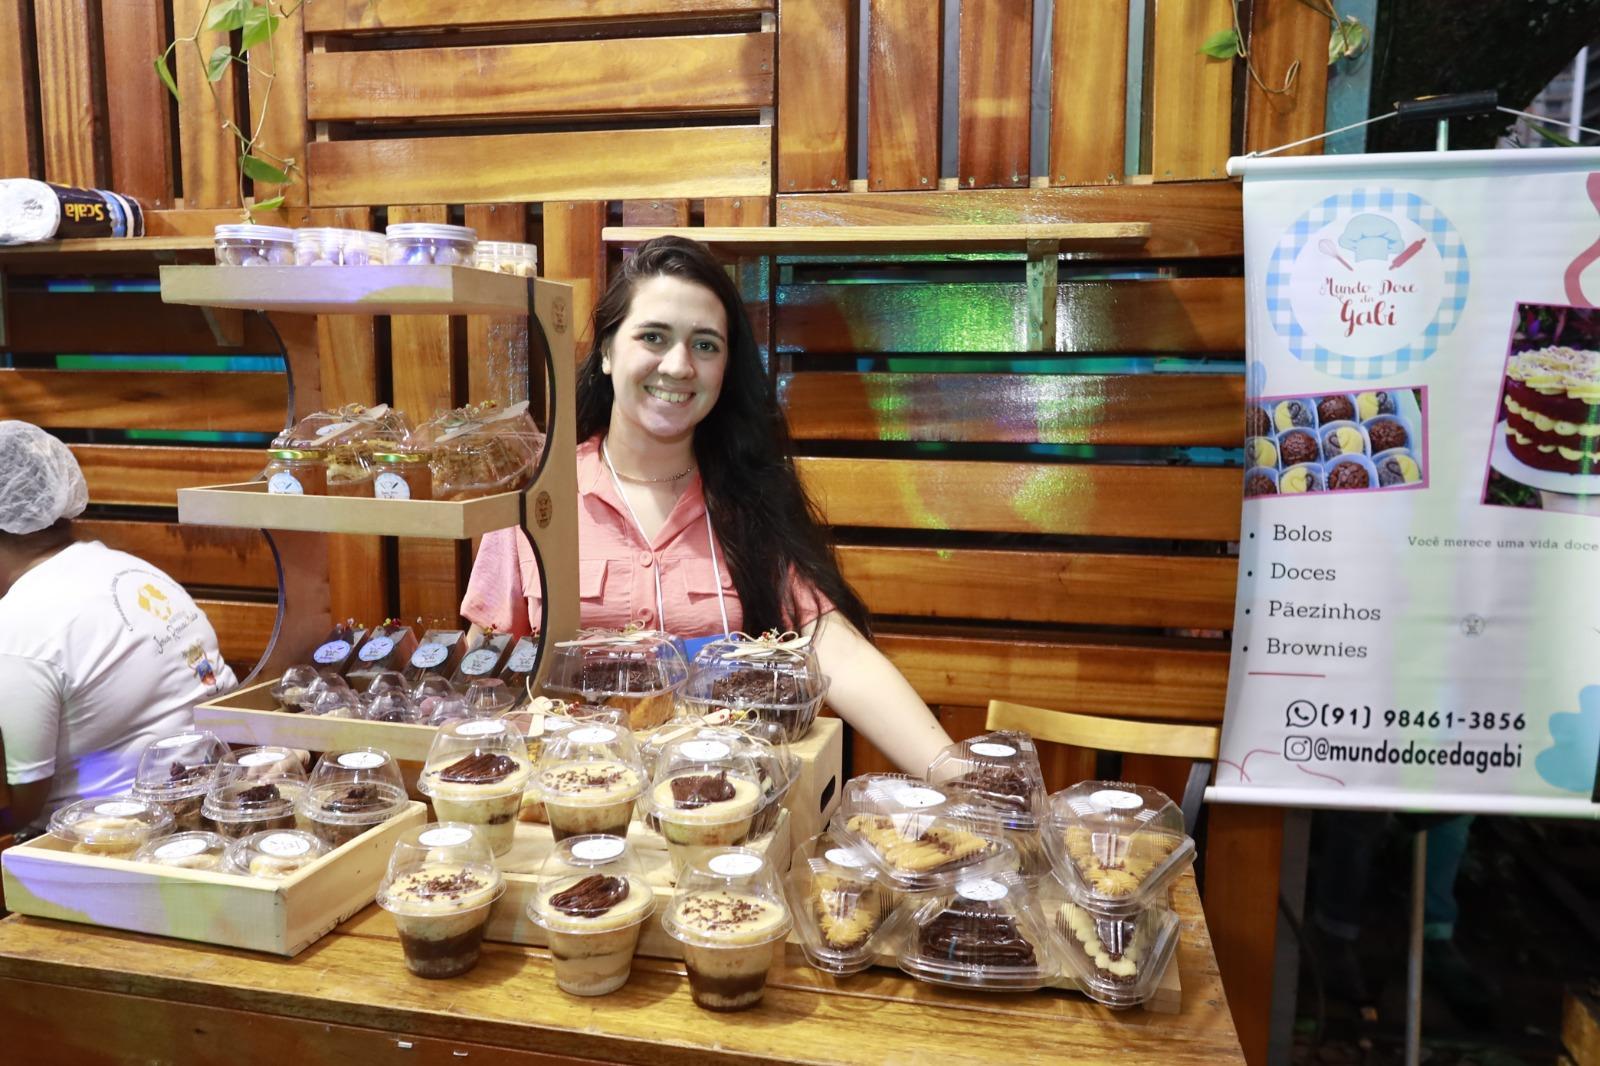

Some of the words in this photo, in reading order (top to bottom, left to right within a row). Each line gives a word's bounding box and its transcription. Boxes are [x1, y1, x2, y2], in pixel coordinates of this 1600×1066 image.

[64, 203, 105, 222] Scala
[1319, 277, 1371, 296] Mundo
[1379, 279, 1418, 295] Doce
[1340, 298, 1397, 338] Gabi
[1272, 523, 1333, 543] Bolos
[1407, 535, 1440, 547] Você
[1444, 538, 1492, 549] merece
[1496, 539, 1525, 549] uma
[1529, 538, 1559, 550] vida
[1270, 562, 1337, 582] Doces
[1268, 599, 1382, 621] Pãezinhos
[1266, 637, 1369, 659] Brownies
[1321, 703, 1372, 729] (91)
[1383, 708, 1527, 731] 98461-3856
[1313, 737, 1523, 774] @mundodocedagabi
